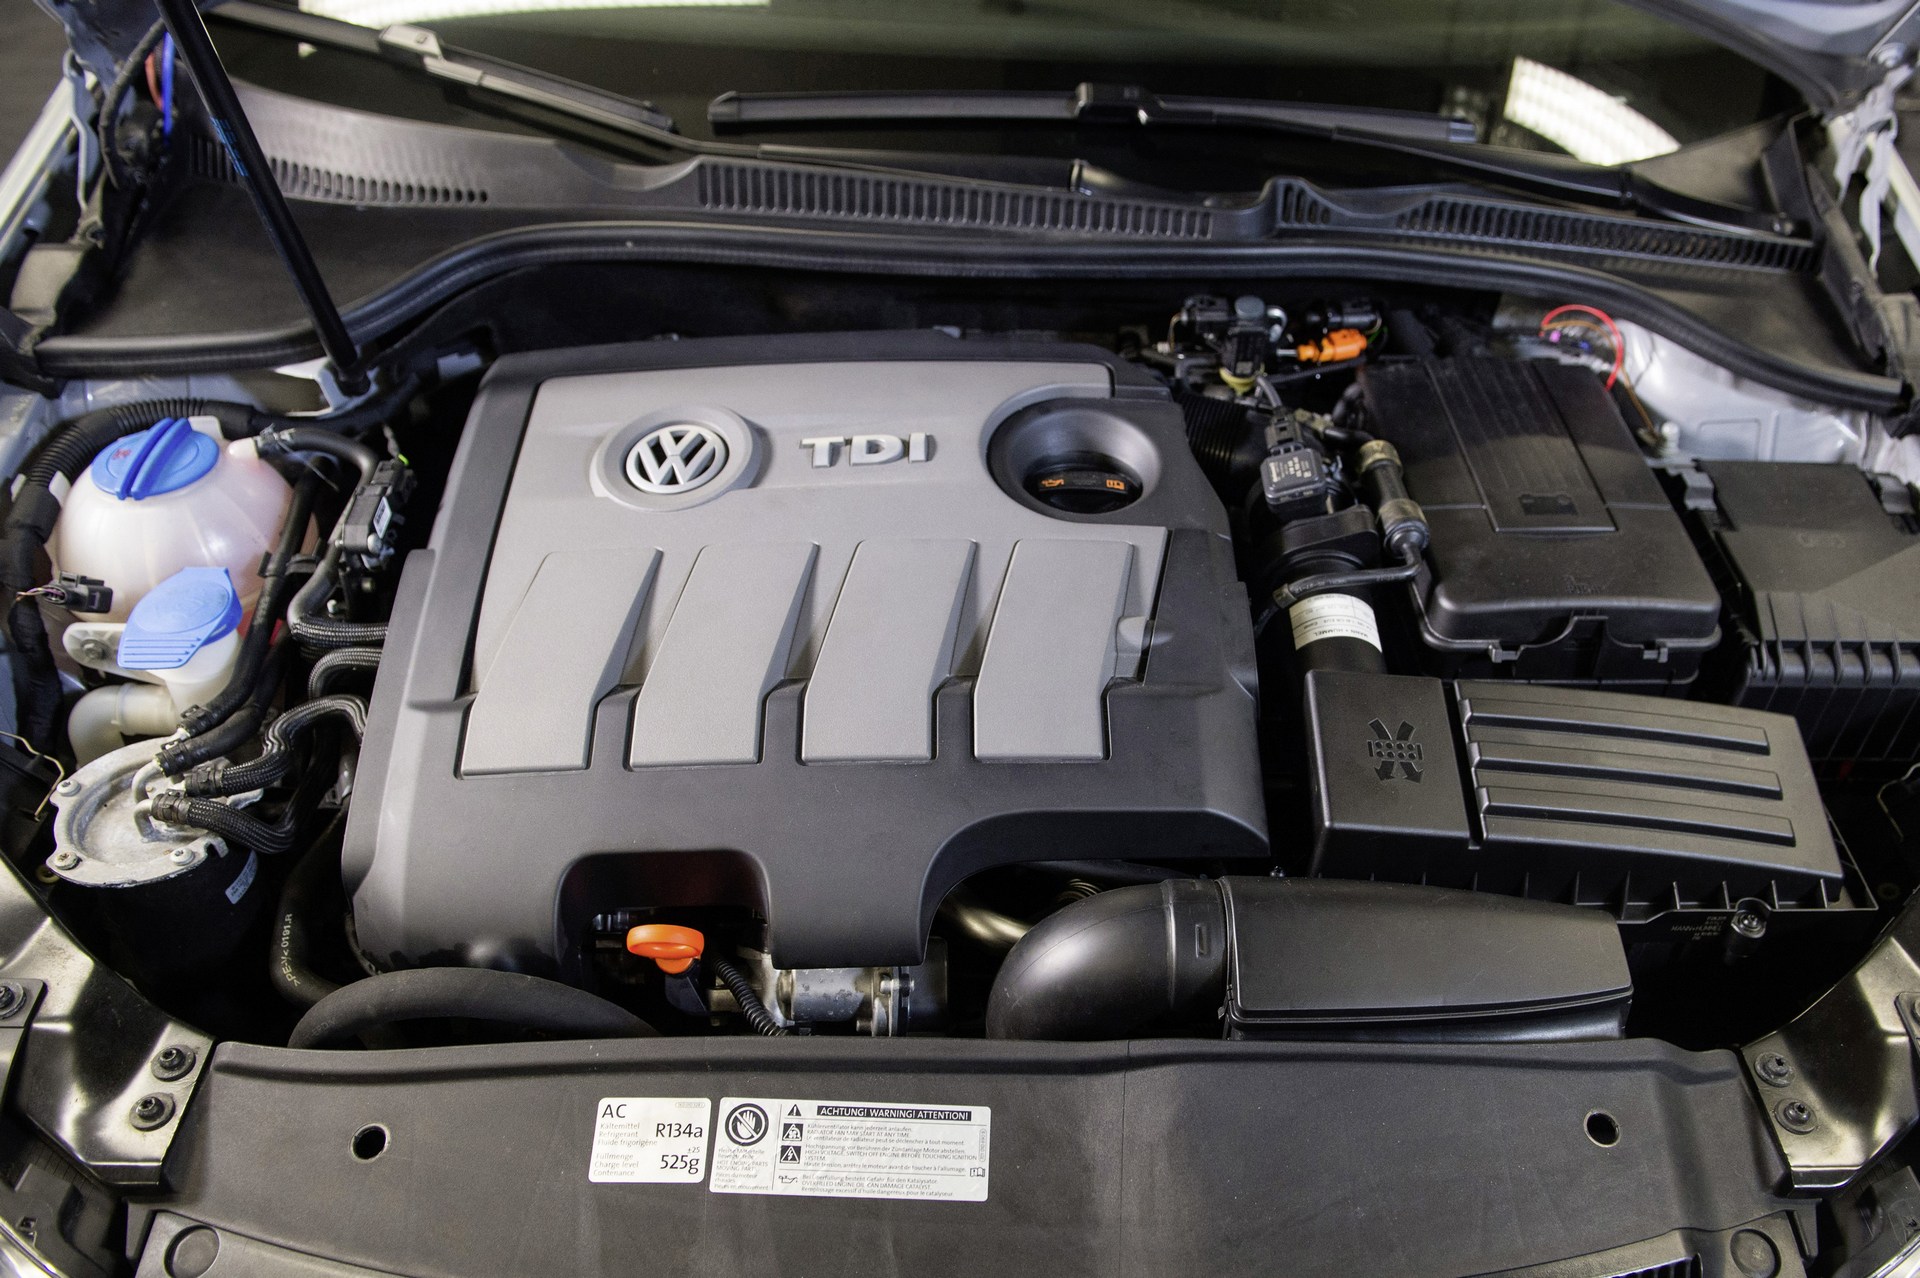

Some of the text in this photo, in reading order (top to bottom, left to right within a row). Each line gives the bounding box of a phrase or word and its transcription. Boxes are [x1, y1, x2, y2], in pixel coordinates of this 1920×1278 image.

[625, 424, 729, 493] VW
[801, 432, 931, 468] TDI
[602, 1104, 627, 1118] AC
[820, 1107, 968, 1120] ACHTUNG! WARNING! ATTENTION!
[656, 1123, 703, 1138] R134a
[660, 1154, 700, 1174] 525g
